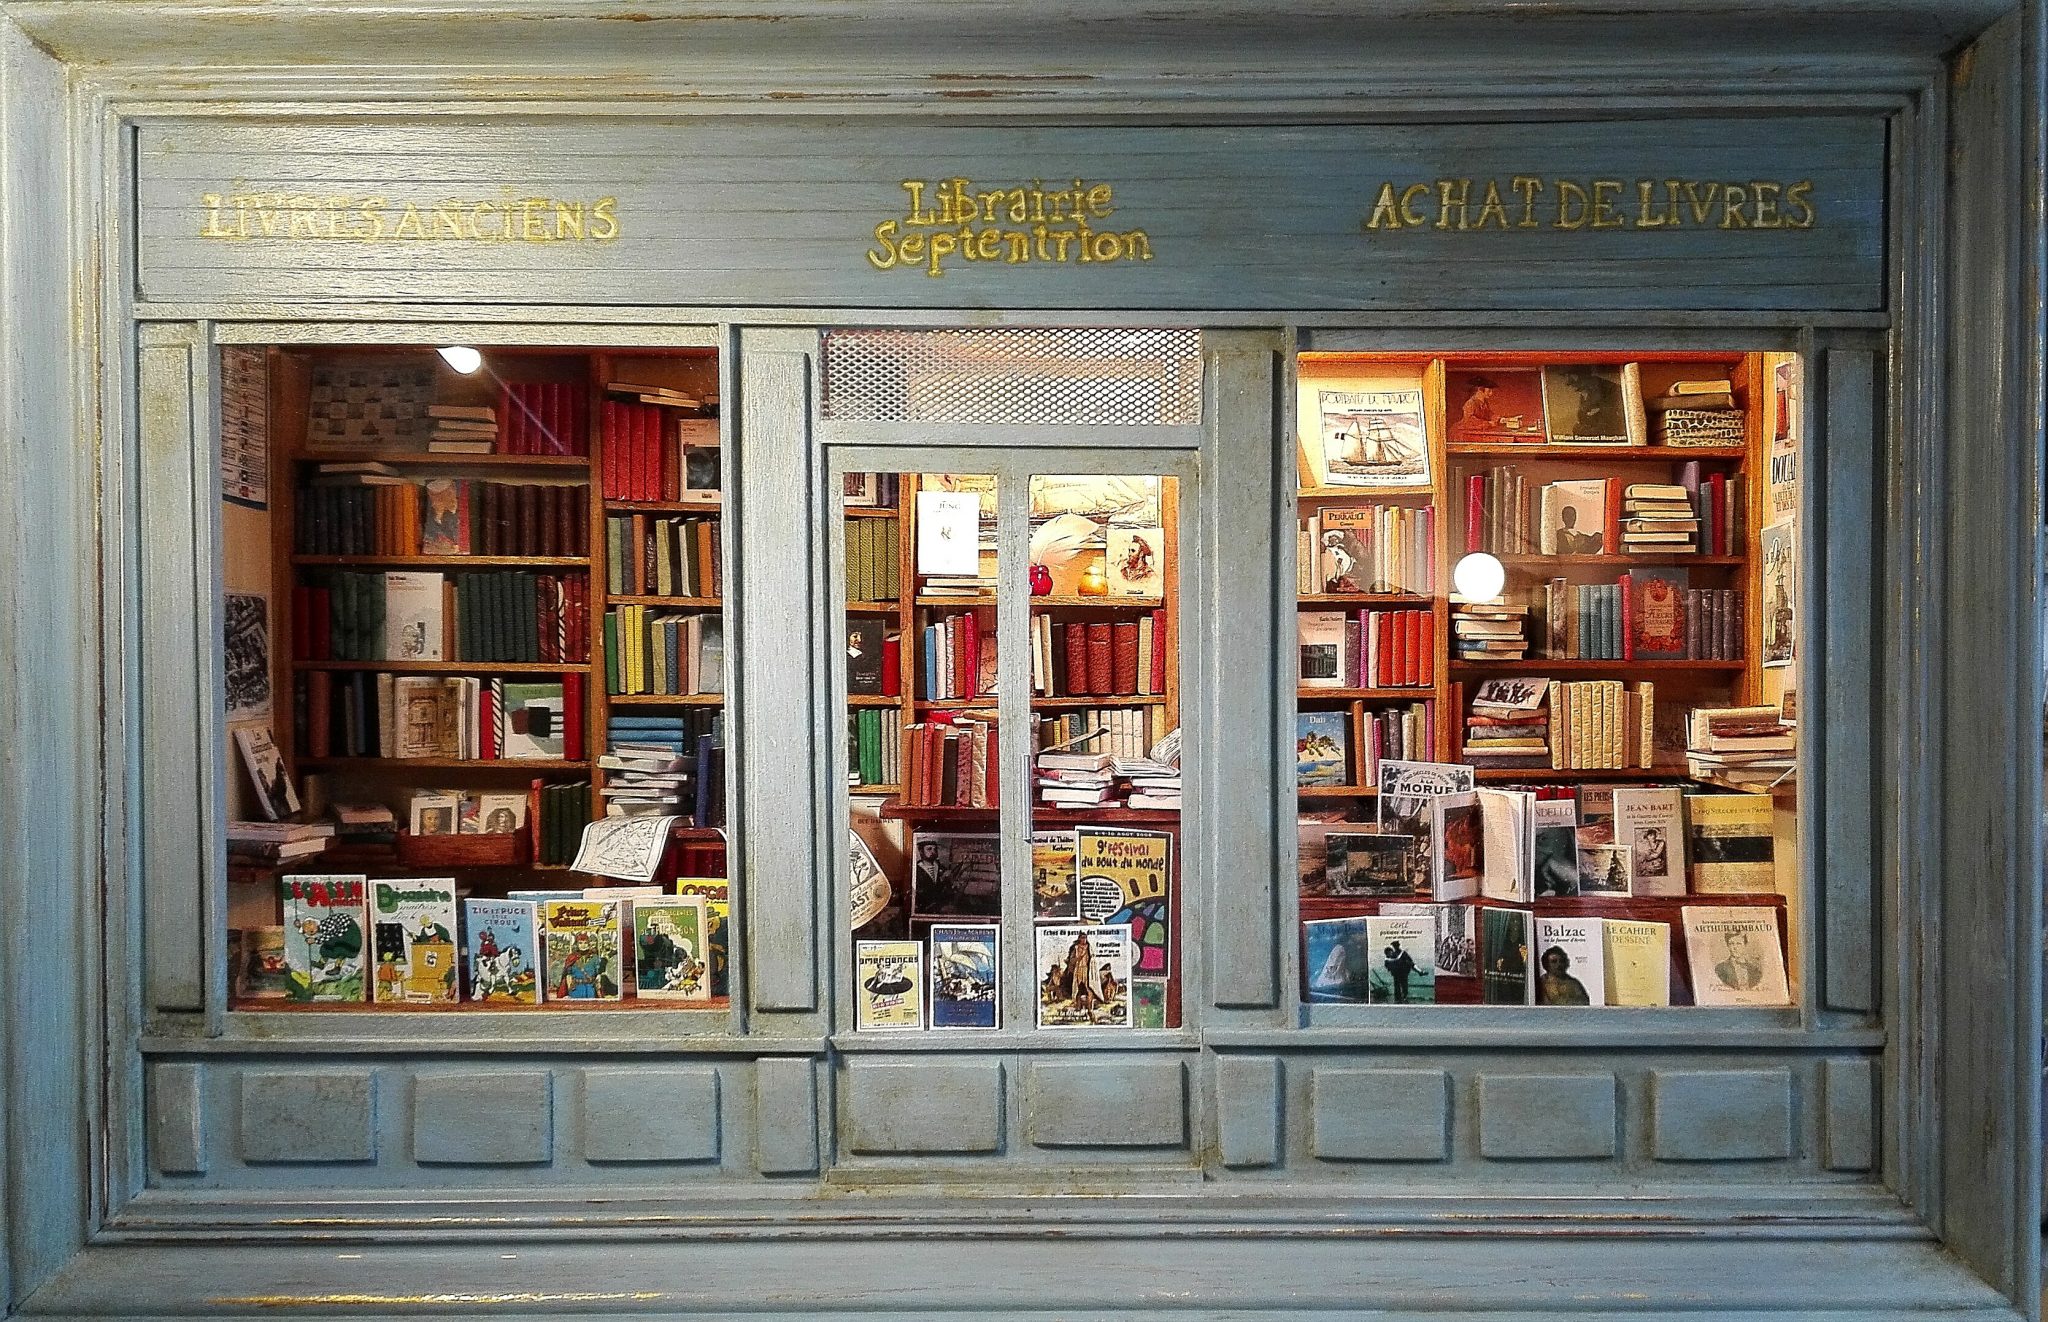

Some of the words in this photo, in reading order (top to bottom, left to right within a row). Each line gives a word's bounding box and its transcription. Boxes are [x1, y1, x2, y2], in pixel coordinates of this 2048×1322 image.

[902, 176, 1116, 225] Librairie
[1366, 175, 1544, 230] ACHAT
[1552, 179, 1625, 230] DE
[1634, 179, 1816, 230] LIVRES
[201, 192, 388, 241] LIVRES
[394, 190, 623, 242] ANCIENS
[867, 218, 1153, 278] Septentrion
[1600, 434, 1628, 442] Maugham
[1772, 452, 1796, 485] DOUA
[1328, 512, 1366, 521] PERRAULT
[1535, 807, 1573, 818] NDELLO
[1625, 803, 1648, 812] JEAN
[1650, 803, 1674, 812] BART
[1081, 856, 1093, 868] du
[1120, 856, 1133, 870] du
[472, 907, 488, 915] ZIG
[501, 907, 527, 915] PUCE
[1543, 924, 1586, 937] Balzac
[1619, 926, 1657, 936] CAHIER
[1694, 923, 1730, 933] ARTHUR
[1731, 923, 1773, 933] RIMBAUD
[859, 956, 919, 967] emergences
